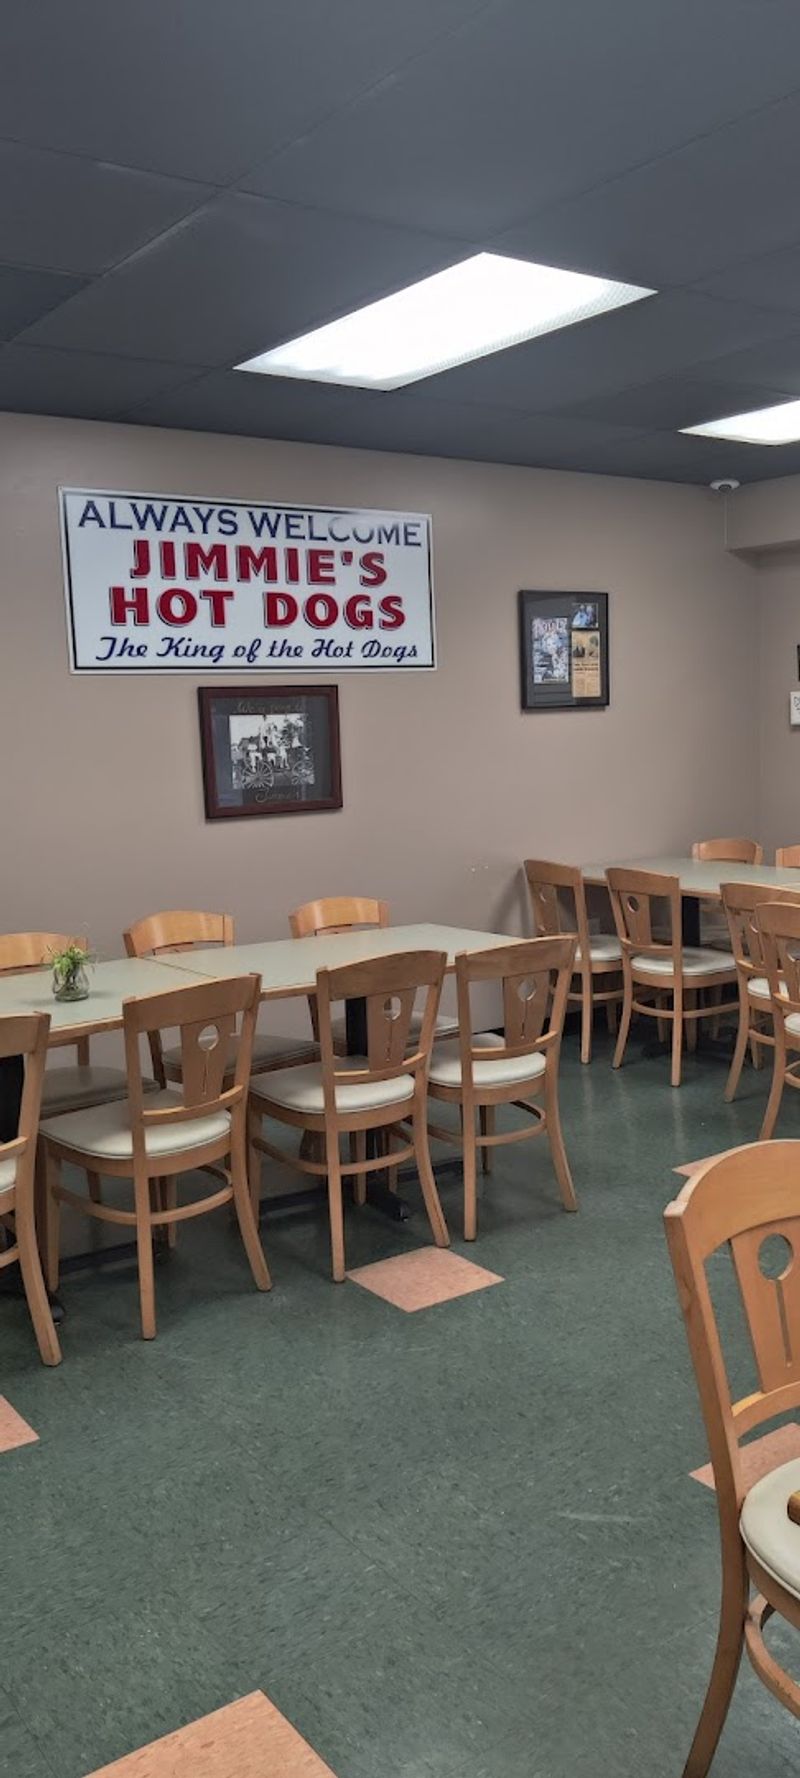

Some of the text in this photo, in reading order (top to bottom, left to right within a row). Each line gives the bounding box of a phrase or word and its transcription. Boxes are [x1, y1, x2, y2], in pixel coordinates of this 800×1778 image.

[78, 499, 422, 547] ALWAYS WELCOME
[130, 539, 388, 588] JIMMIE'S
[109, 586, 406, 631] HOT DOGS
[96, 636, 418, 663] The King of the Hot Dogs
